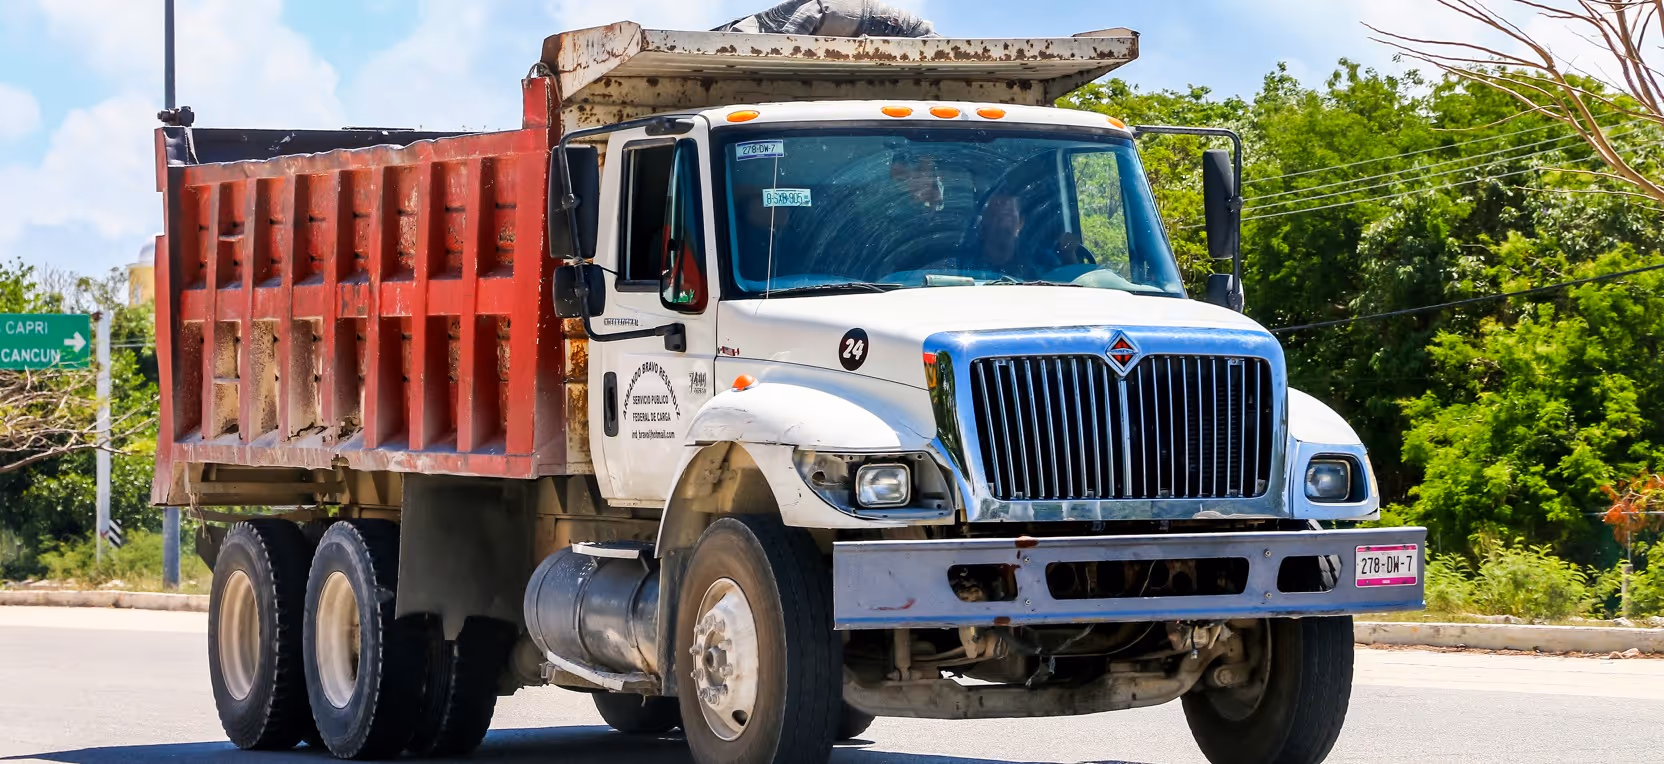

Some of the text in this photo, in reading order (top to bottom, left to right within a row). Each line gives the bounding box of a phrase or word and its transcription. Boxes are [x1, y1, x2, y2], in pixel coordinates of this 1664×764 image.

[742, 144, 776, 155] 278-DW-7
[5, 321, 48, 335] CAPRI
[0, 348, 60, 362] CANCUN
[842, 338, 865, 361] 24
[623, 361, 681, 420] ARMANDO BRAVO RESENDIZ
[632, 395, 669, 404] SERVICIO PUBLICO
[632, 412, 671, 421] FEDERAL DE CARGA
[1361, 555, 1412, 574] 278-DW-7
